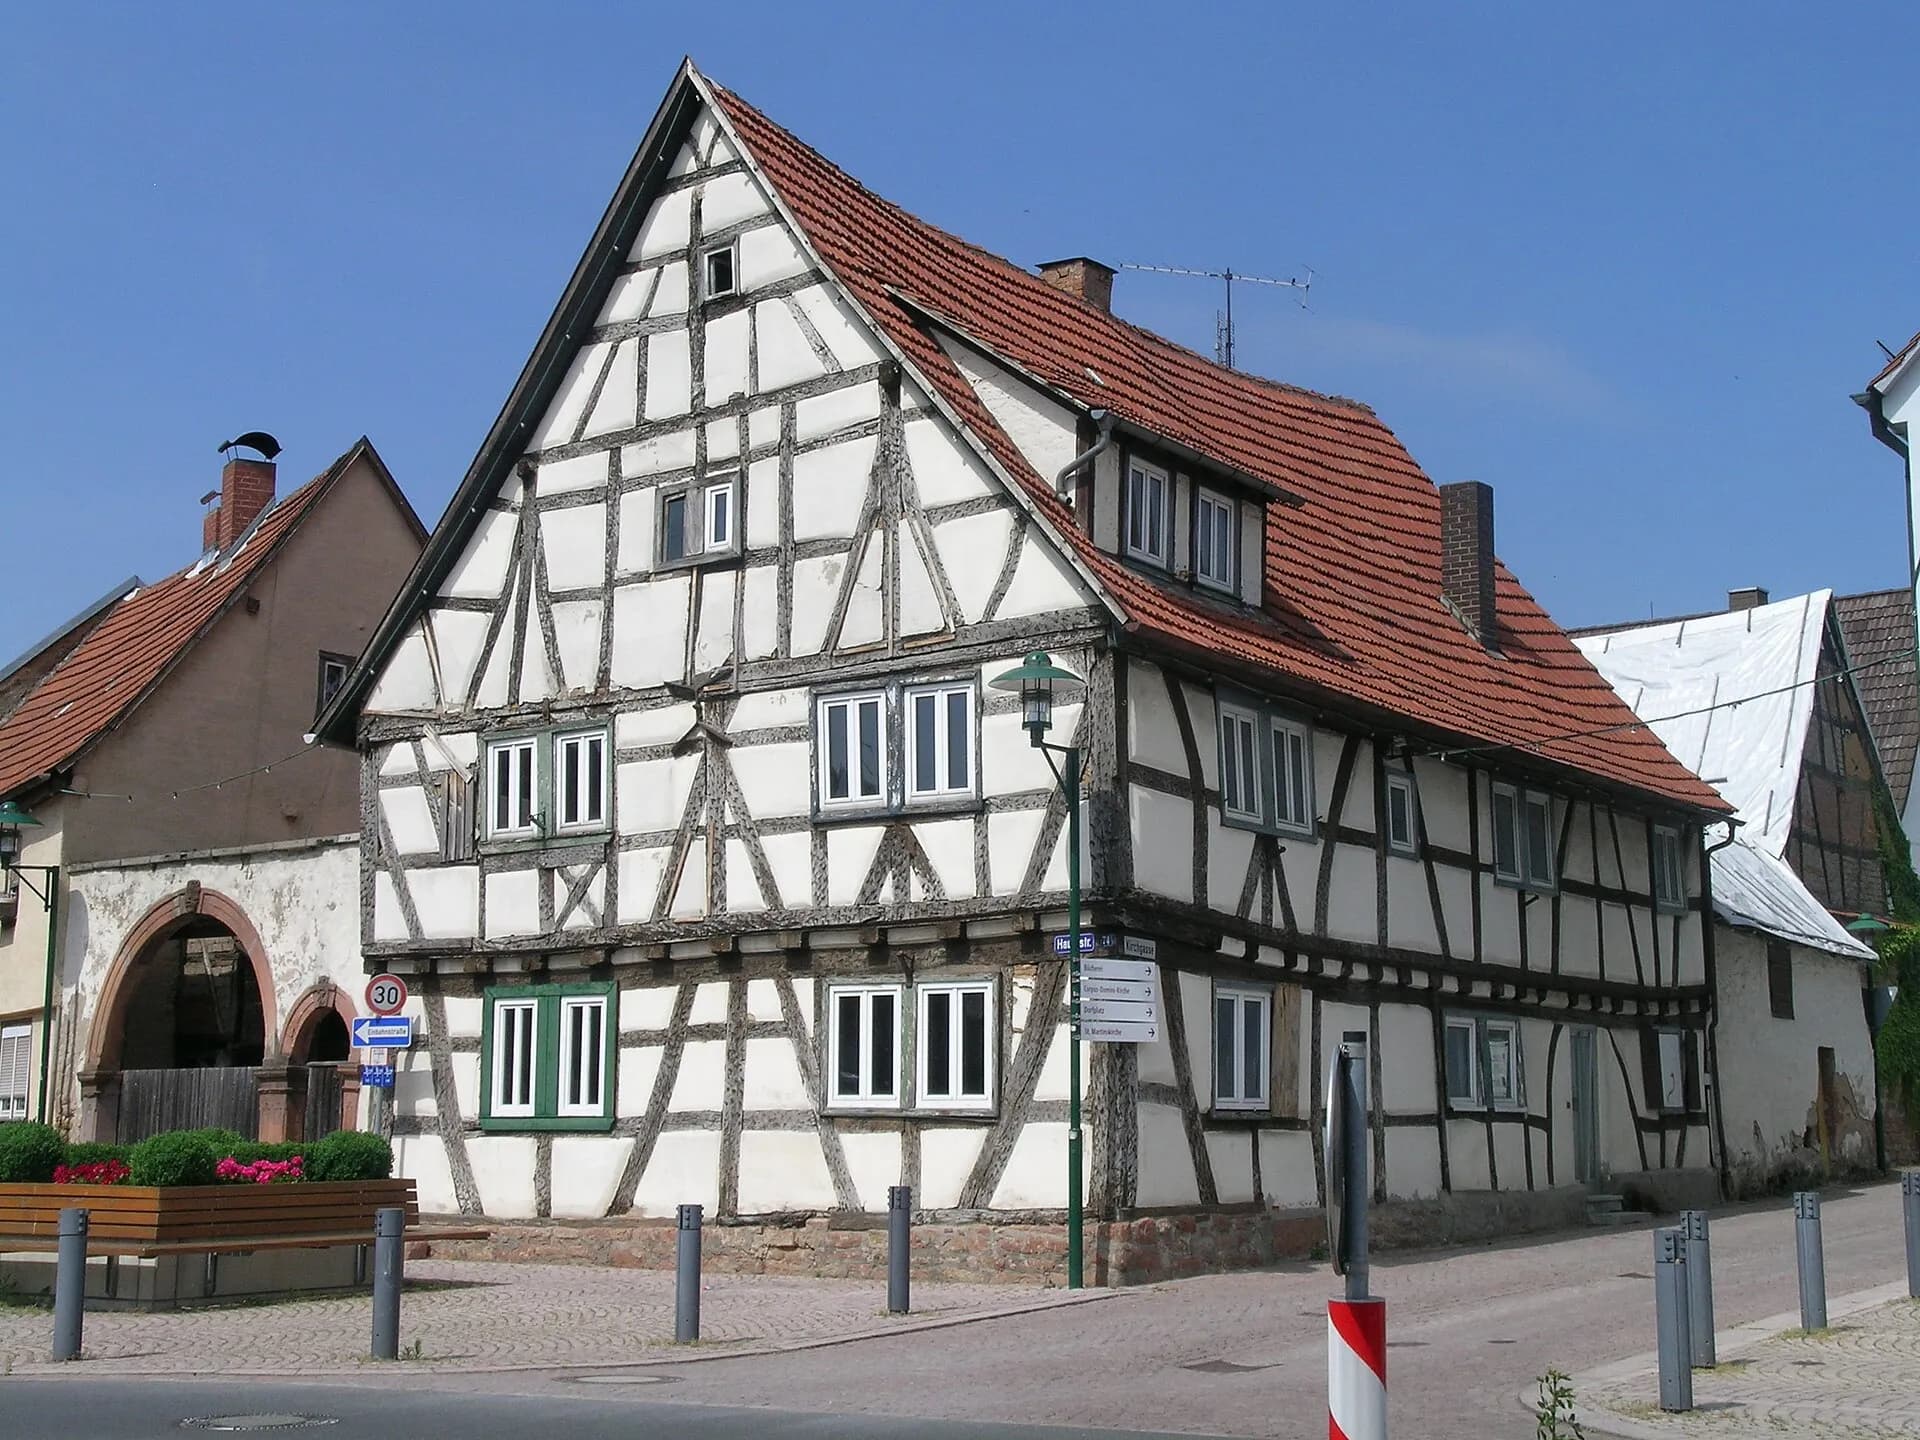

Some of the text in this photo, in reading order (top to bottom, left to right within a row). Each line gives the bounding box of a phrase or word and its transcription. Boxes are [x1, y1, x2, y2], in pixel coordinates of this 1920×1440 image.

[1057, 937, 1092, 950] Haustr.
[1127, 941, 1154, 955] Kirchgasse
[374, 986, 398, 1004] 30
[1084, 1006, 1104, 1014] Dorfplatz
[368, 1027, 406, 1036] Einbahnstraße
[1091, 1027, 1122, 1036] Martinskirche
